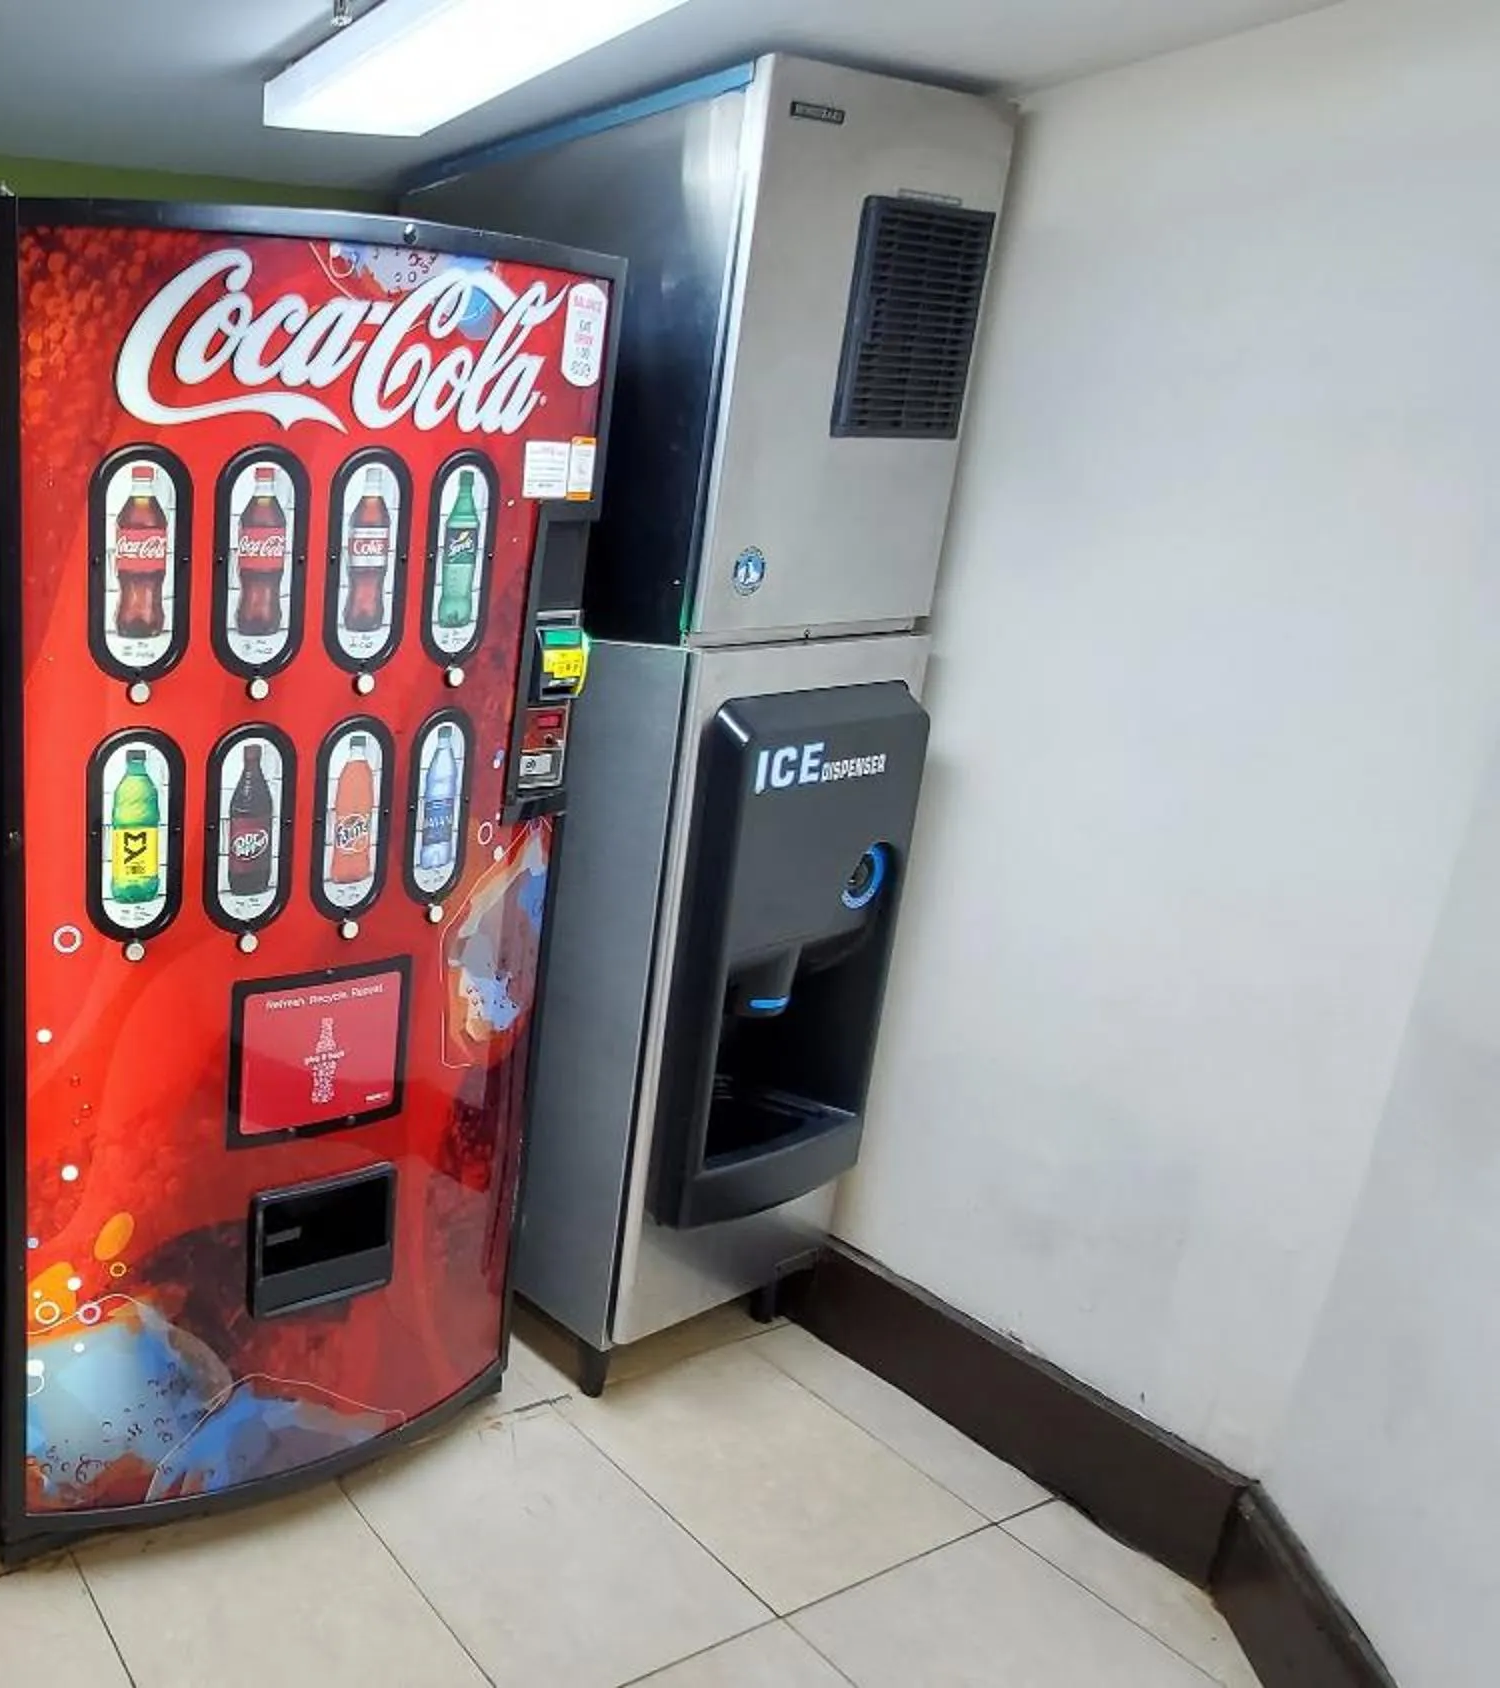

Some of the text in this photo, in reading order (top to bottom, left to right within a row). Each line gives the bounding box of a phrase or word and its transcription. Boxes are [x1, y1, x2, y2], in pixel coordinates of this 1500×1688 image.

[115, 248, 570, 435] Coca-Cola
[755, 741, 887, 795] ICE DISPENSER
